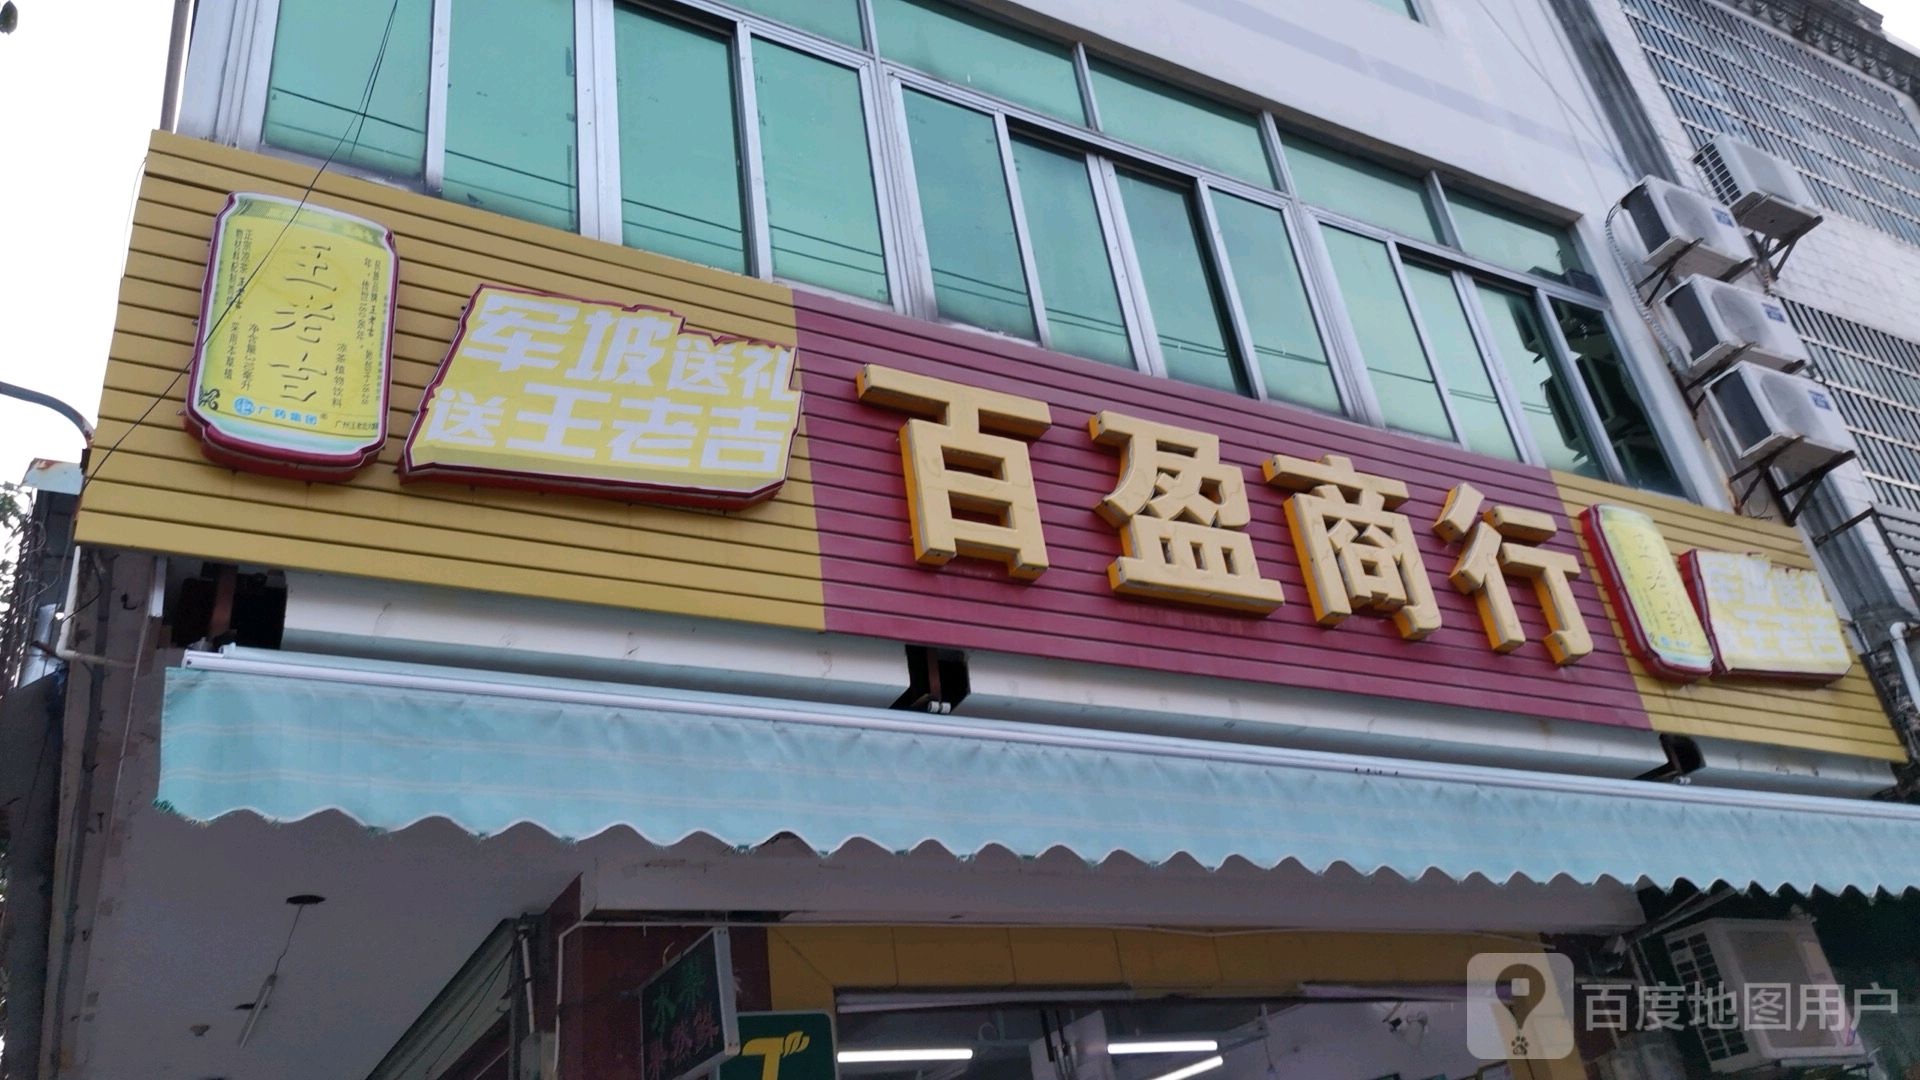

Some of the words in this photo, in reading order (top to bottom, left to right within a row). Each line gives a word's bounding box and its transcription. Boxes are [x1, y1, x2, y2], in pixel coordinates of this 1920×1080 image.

[462, 294, 798, 400] 军坡送礼
[424, 382, 790, 473] 送王老吉
[856, 362, 1594, 667] 百盈商行
